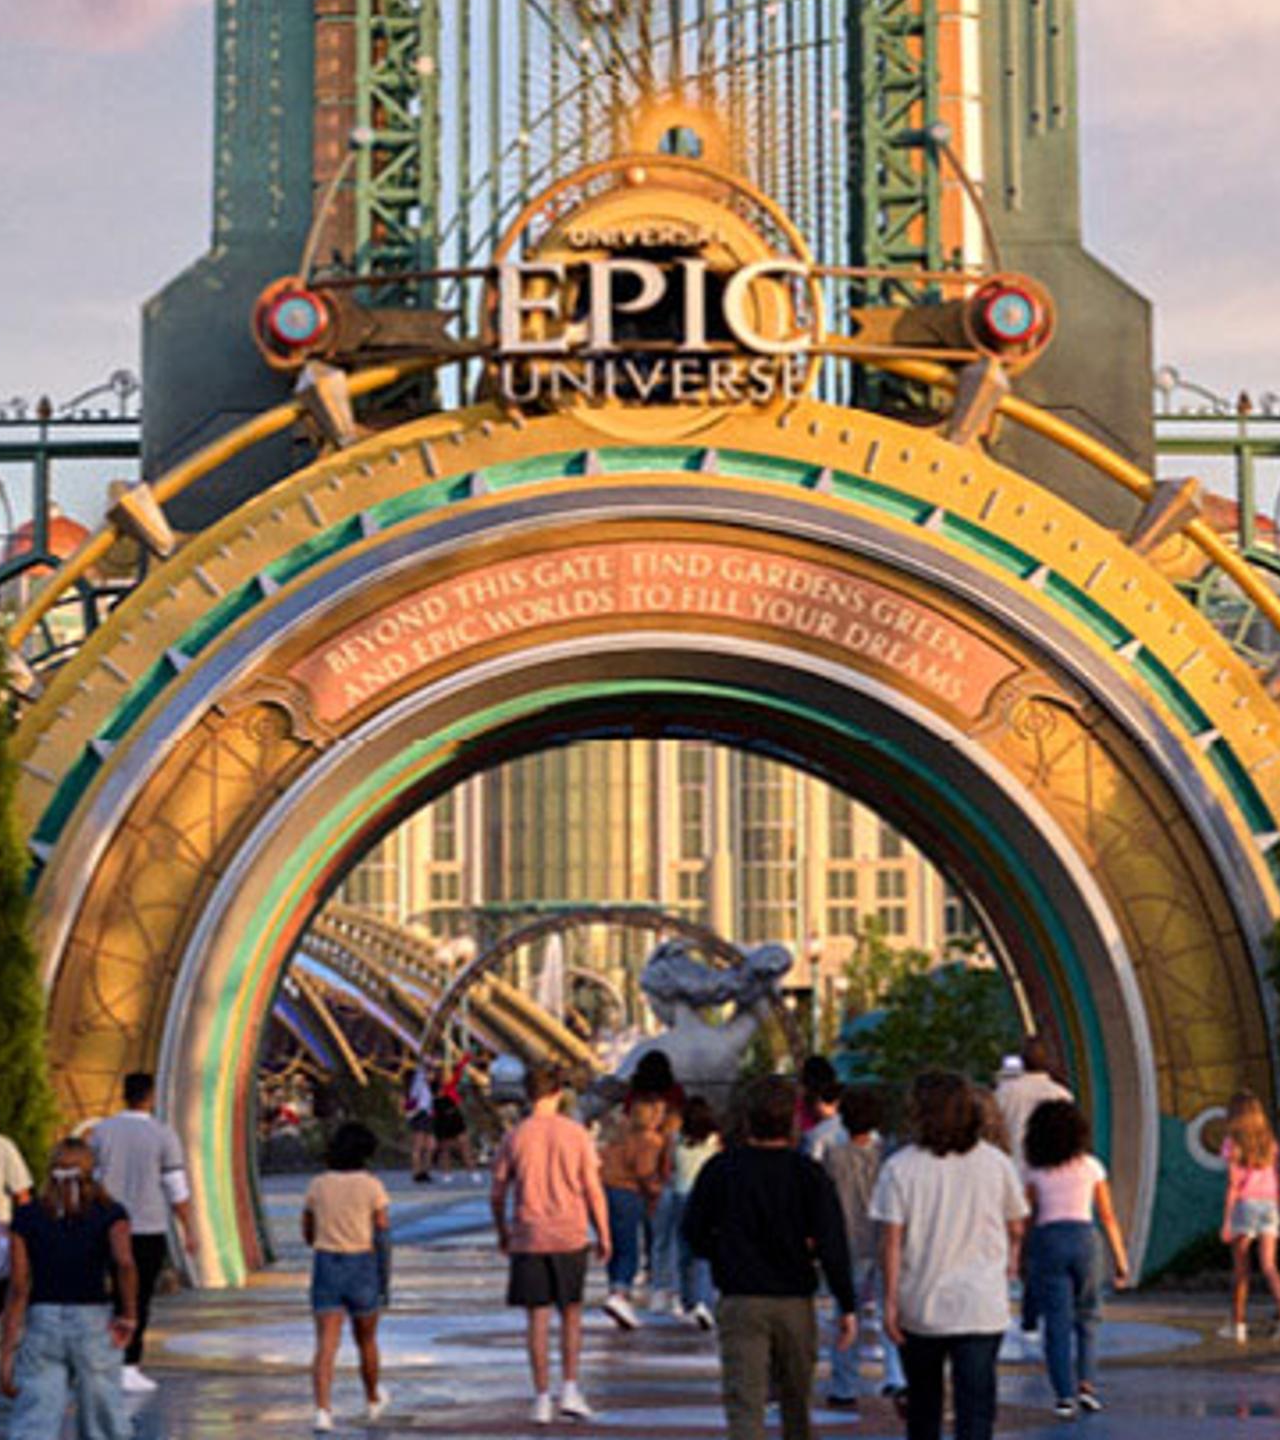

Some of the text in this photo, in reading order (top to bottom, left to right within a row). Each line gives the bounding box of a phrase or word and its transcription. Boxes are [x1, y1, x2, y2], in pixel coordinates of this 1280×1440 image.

[498, 259, 812, 354] EPIC
[503, 358, 807, 401] UNIVERSE
[324, 552, 966, 675] BEYOND THIS GATE FIND GARDENS GREEN
[342, 584, 964, 710] AND EPIC WORLDS TO FILL YOUR DREAMS
